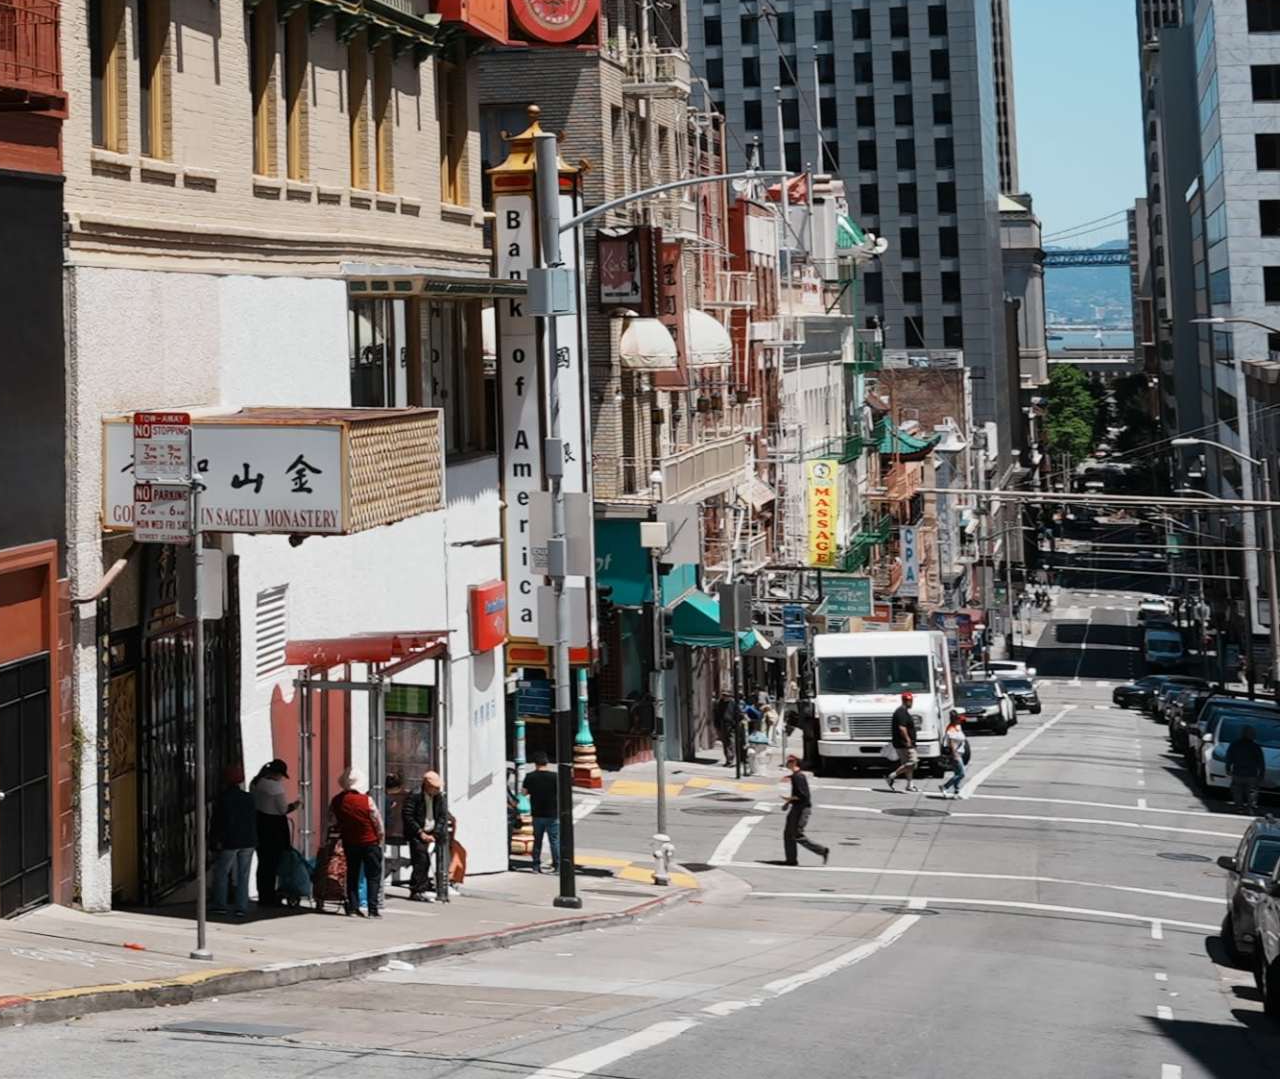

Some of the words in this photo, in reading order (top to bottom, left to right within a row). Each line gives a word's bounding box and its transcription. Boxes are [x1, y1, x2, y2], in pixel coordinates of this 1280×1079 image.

[139, 414, 185, 423] TOW-AWAY
[135, 424, 150, 437] NO
[151, 426, 189, 436] STOPPING
[135, 486, 151, 501] NO
[154, 489, 188, 502] PARKING
[215, 508, 261, 527] SAGELY
[263, 508, 339, 528] MONASTERY
[513, 430, 532, 623] America
[814, 487, 831, 563] MASSAGE
[904, 528, 915, 581] CPA
